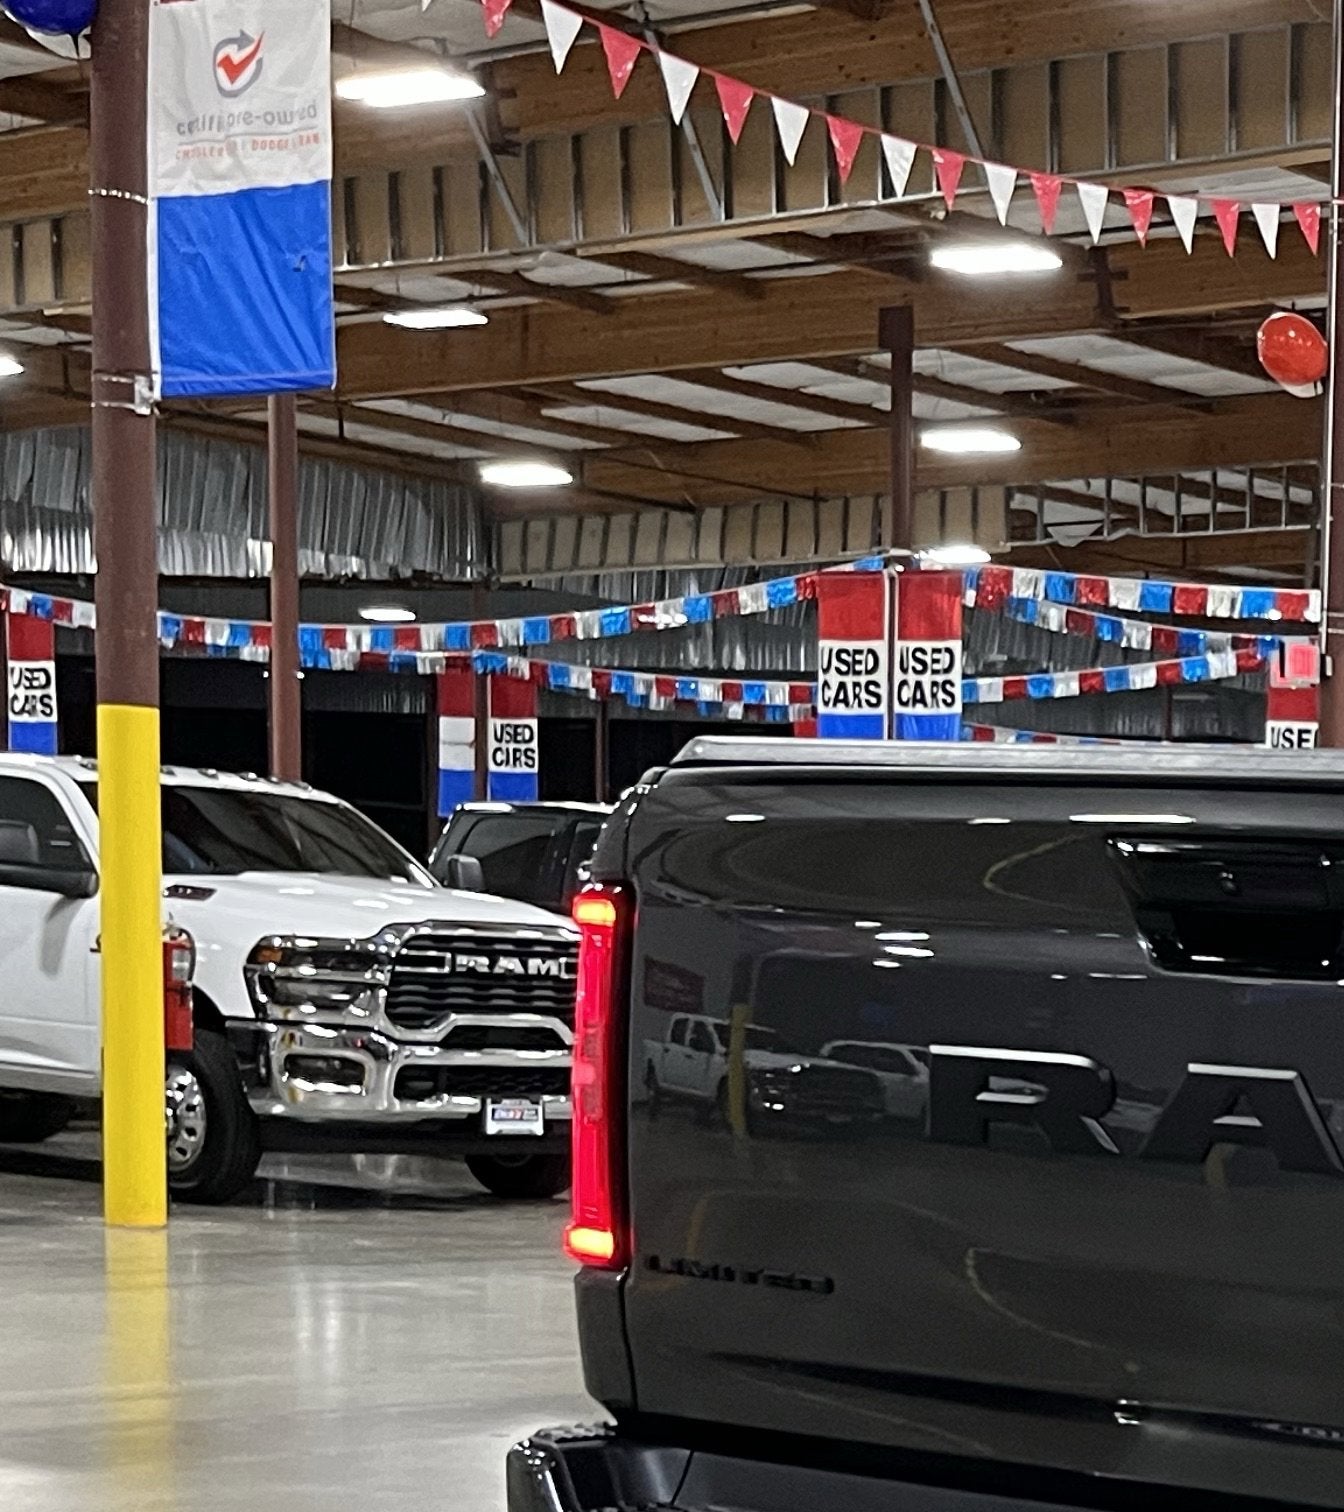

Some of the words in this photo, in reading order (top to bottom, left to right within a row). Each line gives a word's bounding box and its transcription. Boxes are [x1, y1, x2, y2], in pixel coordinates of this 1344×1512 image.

[226, 101, 318, 128] pre-owed
[822, 646, 879, 676] USED
[900, 646, 955, 676] USED
[10, 666, 52, 689] USED
[821, 679, 882, 708] CARS
[897, 679, 956, 708] CARS
[493, 723, 534, 744] USED
[1271, 726, 1318, 749] USE
[455, 953, 559, 976] RAM
